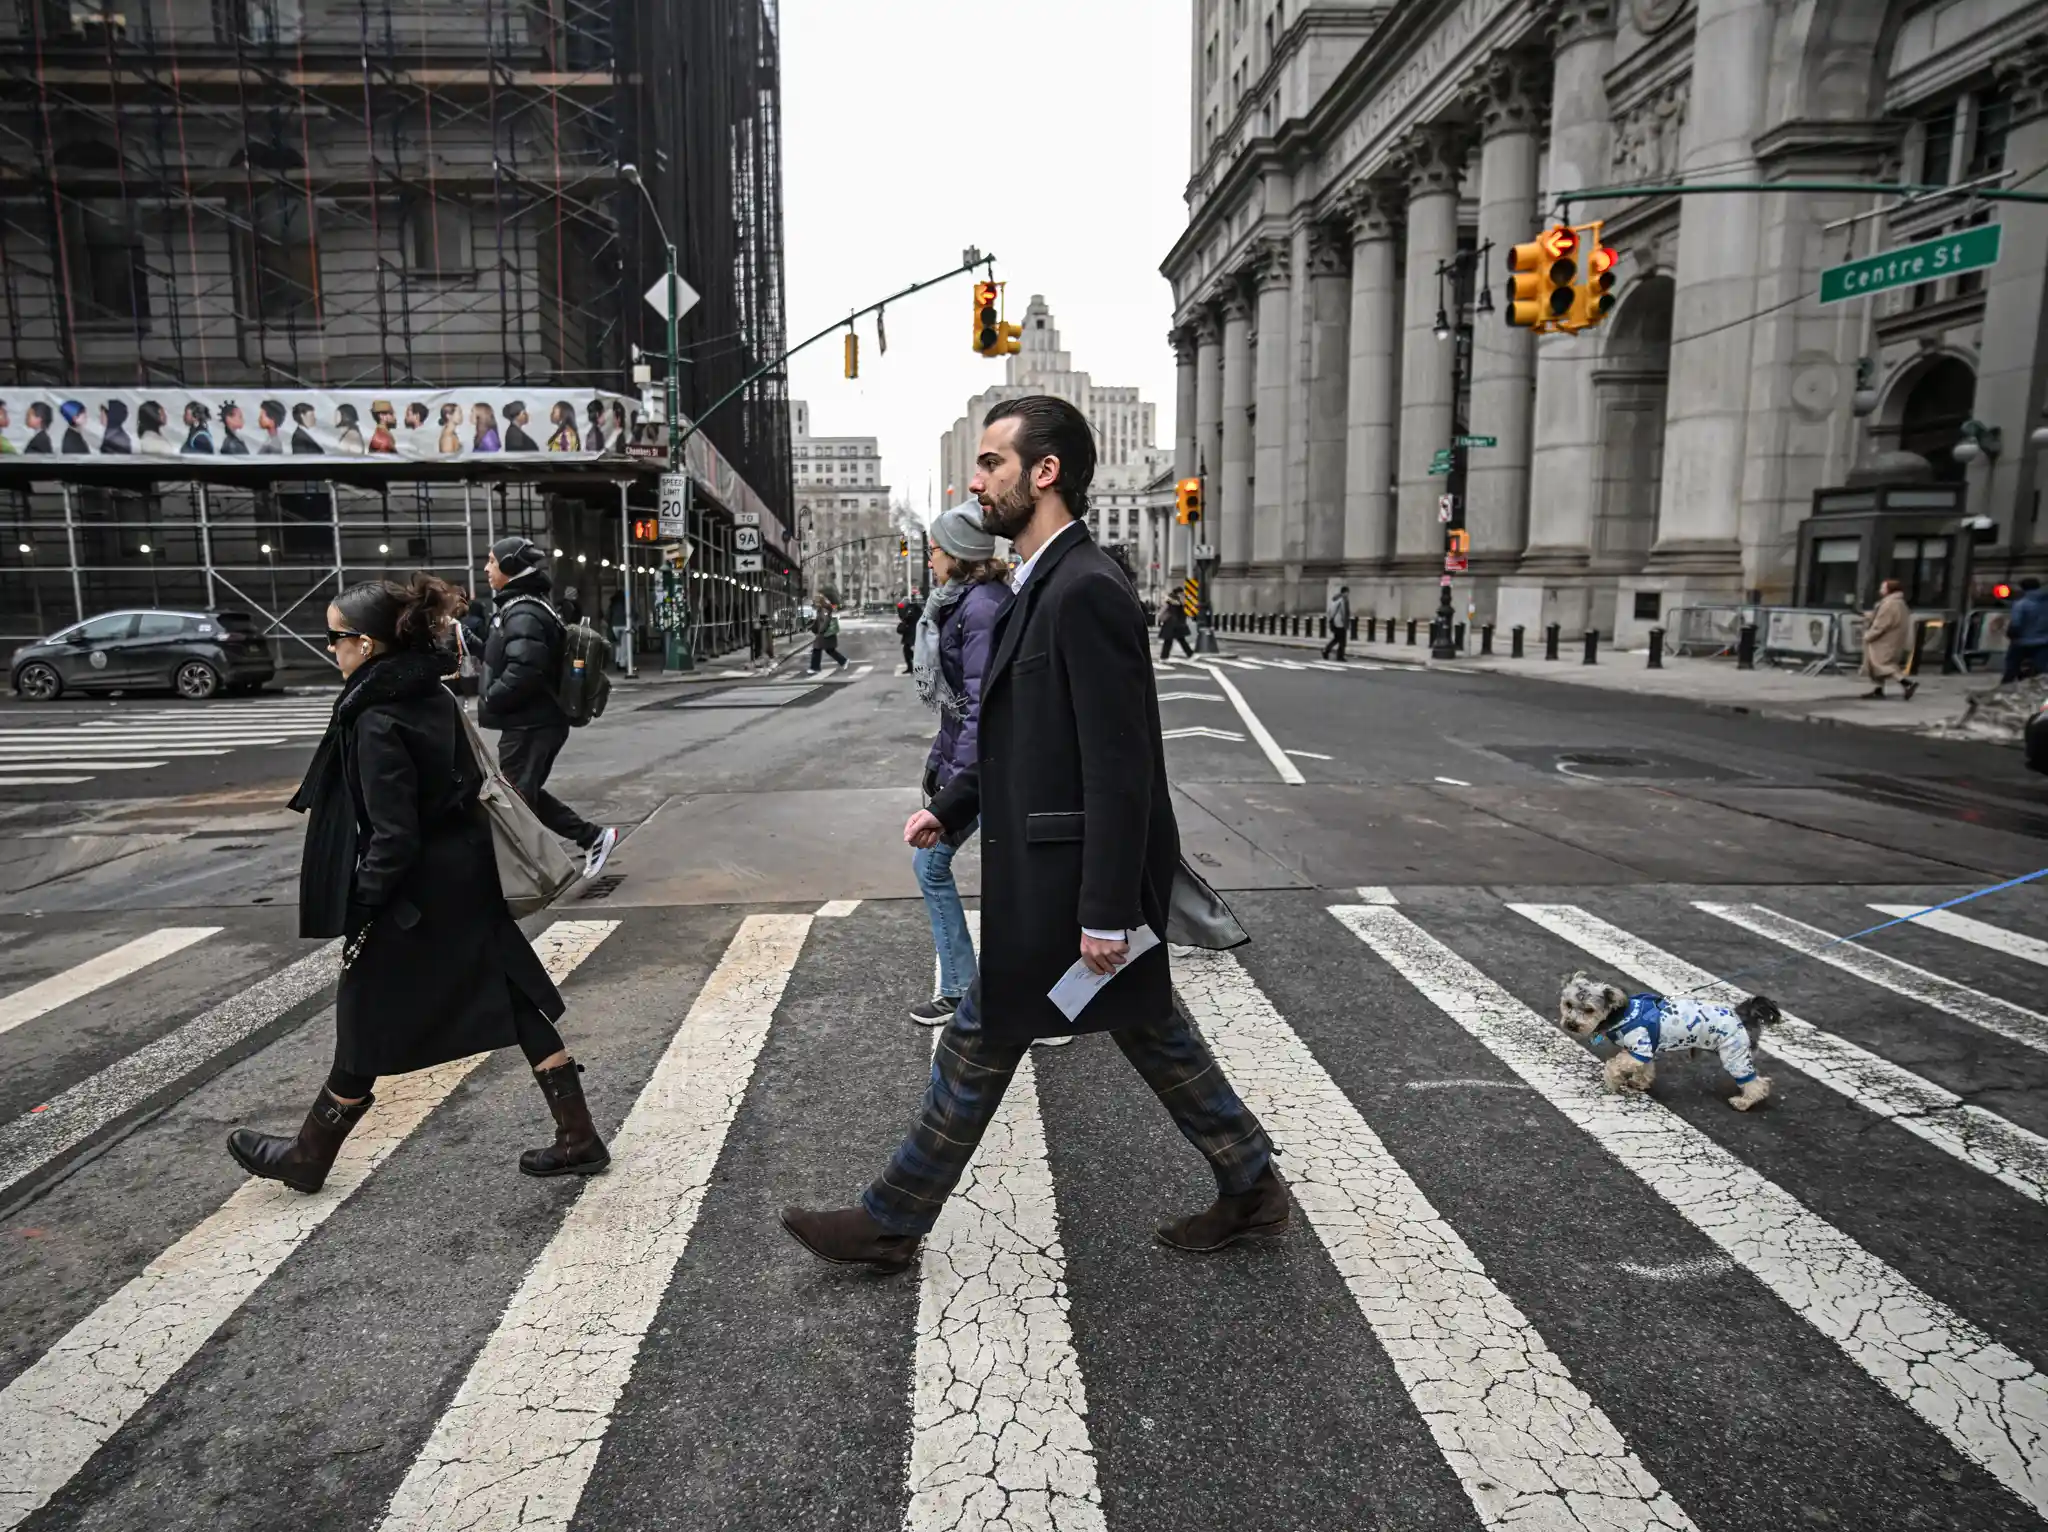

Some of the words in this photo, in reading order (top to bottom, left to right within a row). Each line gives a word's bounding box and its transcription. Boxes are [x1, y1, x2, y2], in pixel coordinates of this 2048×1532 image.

[1844, 256, 1924, 290] Centre
[1933, 244, 1962, 268] St
[662, 478, 684, 486] SPEED
[661, 500, 681, 517] 20
[741, 514, 754, 523] TO
[738, 532, 756, 545] 9A
